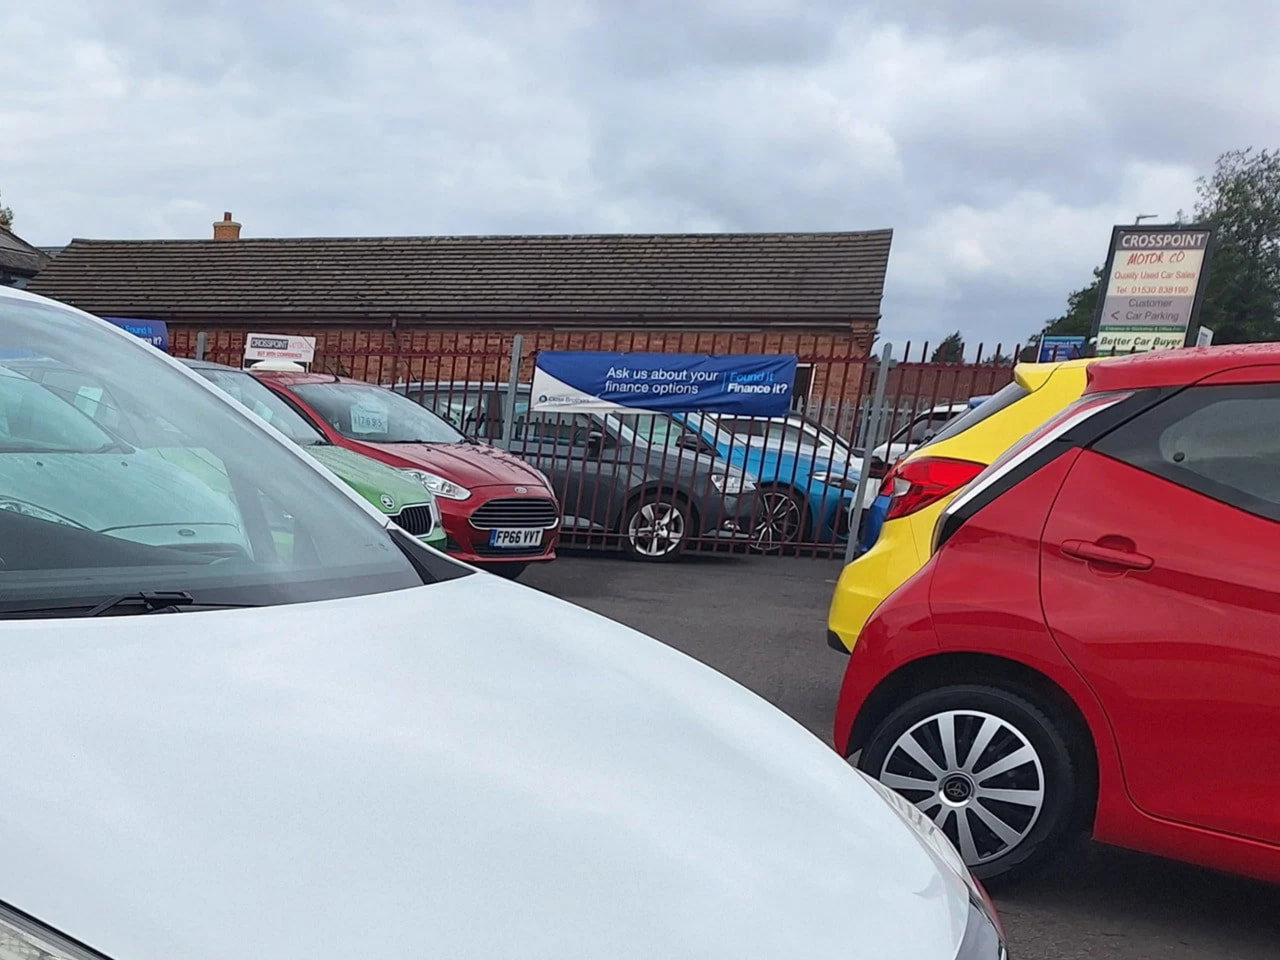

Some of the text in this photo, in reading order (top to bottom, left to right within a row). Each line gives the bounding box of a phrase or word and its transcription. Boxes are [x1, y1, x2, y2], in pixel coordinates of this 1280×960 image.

[1122, 233, 1205, 248] CROSSPOINT
[1127, 250, 1185, 266] MOTOR CO
[1114, 270, 1196, 281] Quality Used Car Sales
[1131, 286, 1156, 294] 01530
[1129, 298, 1173, 308] Customer
[1126, 310, 1180, 322] Car Parking
[1100, 336, 1183, 348] Better Car Buyer
[606, 366, 719, 384] Ask us about your
[730, 371, 763, 382] Found
[605, 380, 699, 396] finance options
[727, 382, 788, 395] Finance it?
[495, 530, 522, 543] FP66
